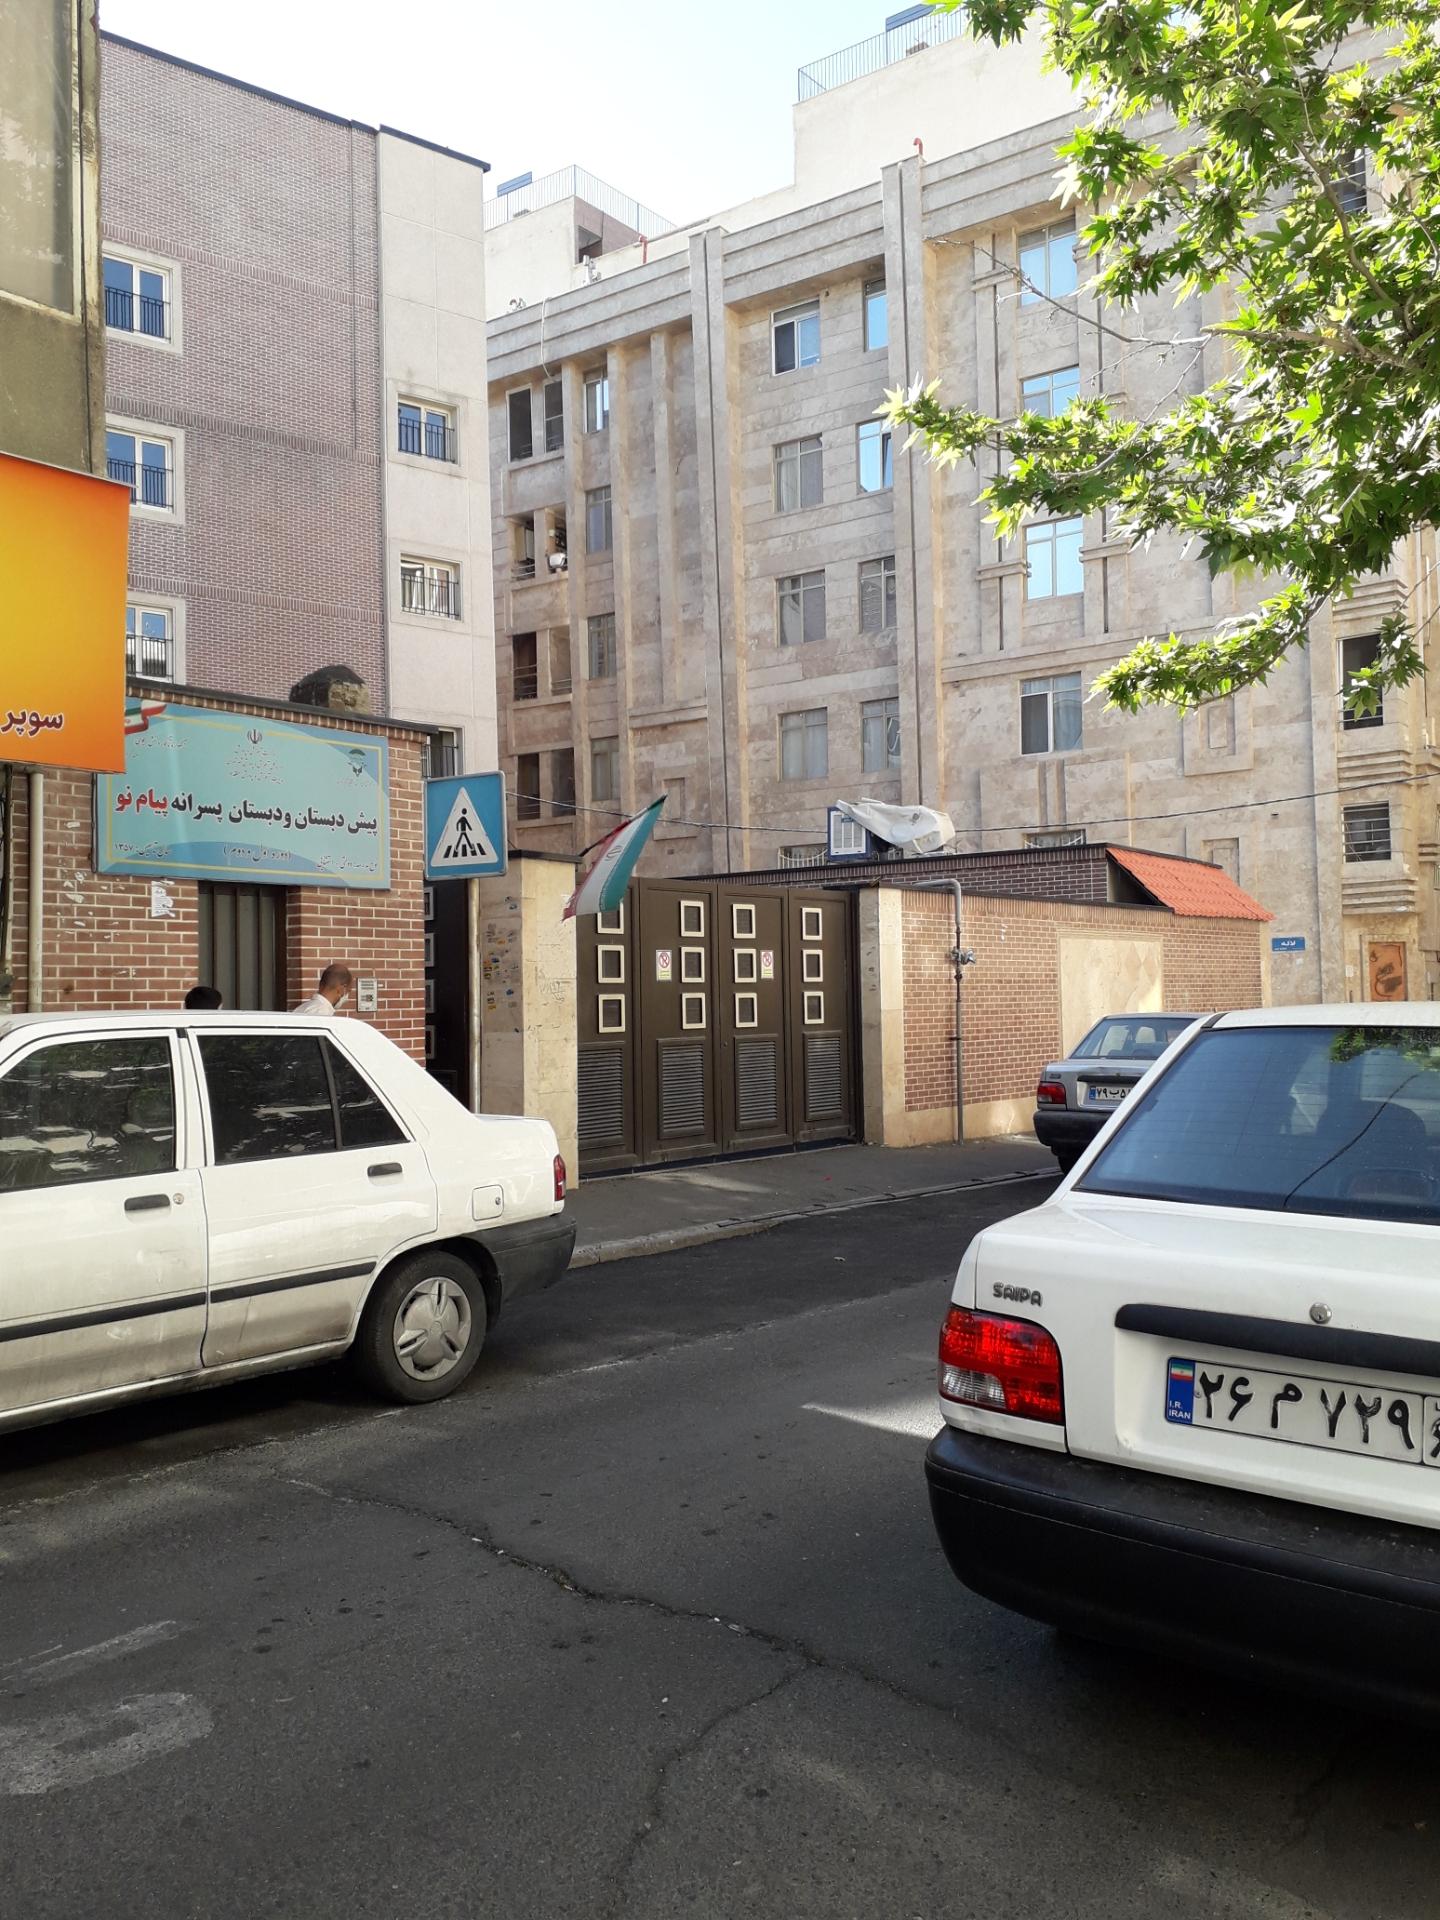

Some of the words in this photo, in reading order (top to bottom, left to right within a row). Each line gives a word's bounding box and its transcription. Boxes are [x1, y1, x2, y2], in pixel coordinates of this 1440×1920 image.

[0, 709, 64, 737] سوپر
[115, 785, 133, 812] نو
[135, 788, 169, 817] پیام
[170, 792, 223, 823] پسرانه
[294, 806, 345, 832] دبستان
[347, 811, 378, 837] پیش
[992, 1281, 1043, 1307] SAIPA
[1168, 1409, 1191, 1420] IRAN
[1199, 1370, 1255, 1422] ۲۶
[1270, 1382, 1304, 1430] م
[1319, 1387, 1416, 1451] ۷۲۹
